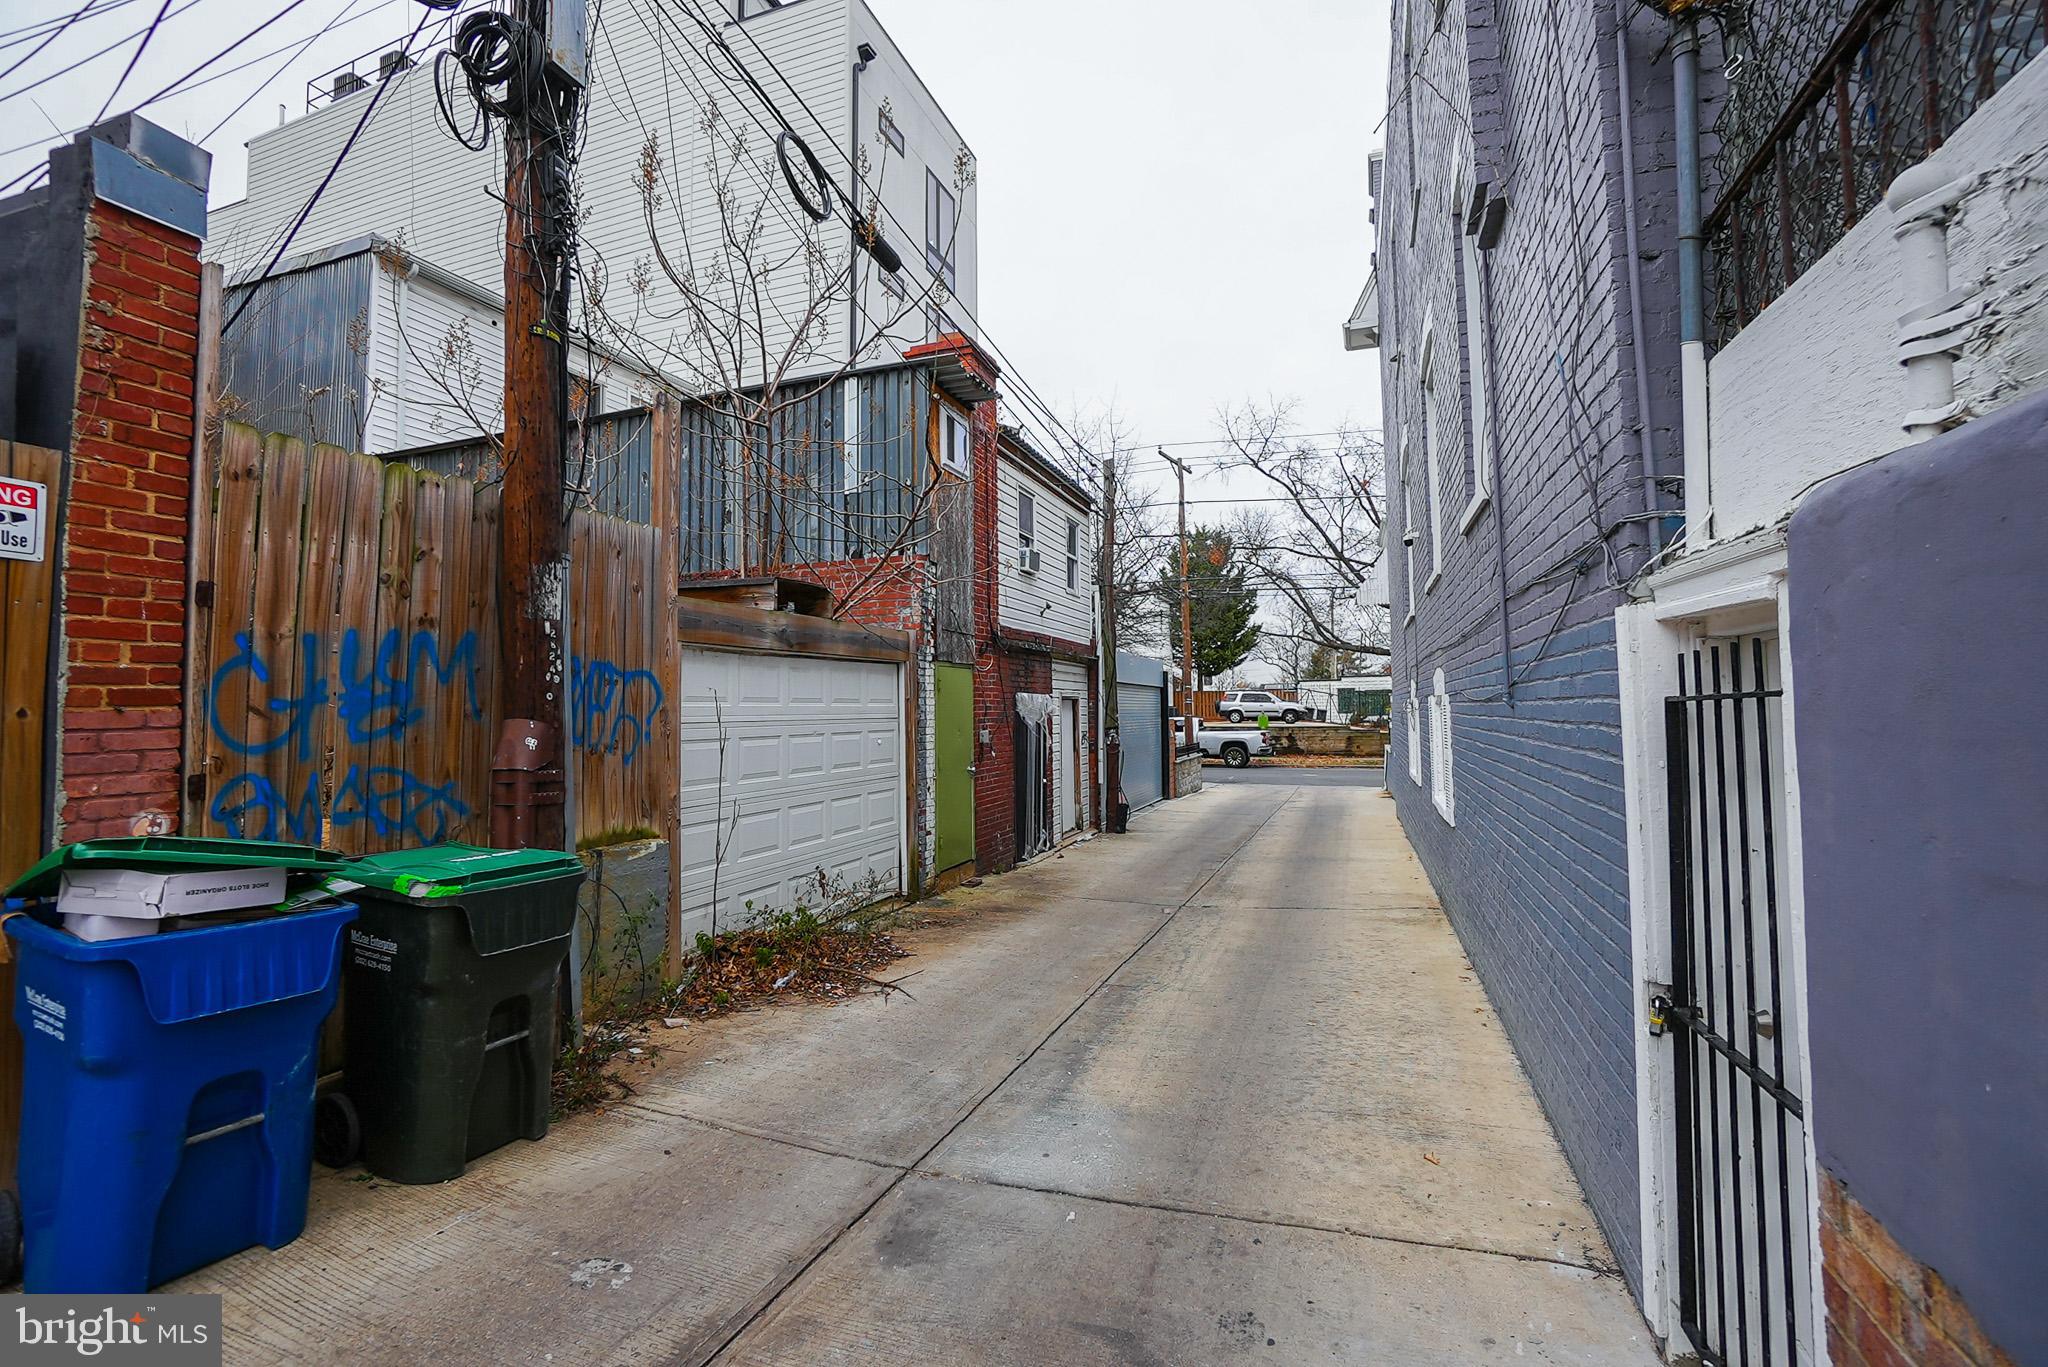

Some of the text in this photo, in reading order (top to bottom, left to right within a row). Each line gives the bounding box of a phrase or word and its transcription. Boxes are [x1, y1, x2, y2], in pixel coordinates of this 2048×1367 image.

[1, 529, 28, 548] Use
[185, 886, 227, 896] ORGANIZER
[229, 883, 250, 892] SLOTS
[370, 934, 397, 952] Enterprise
